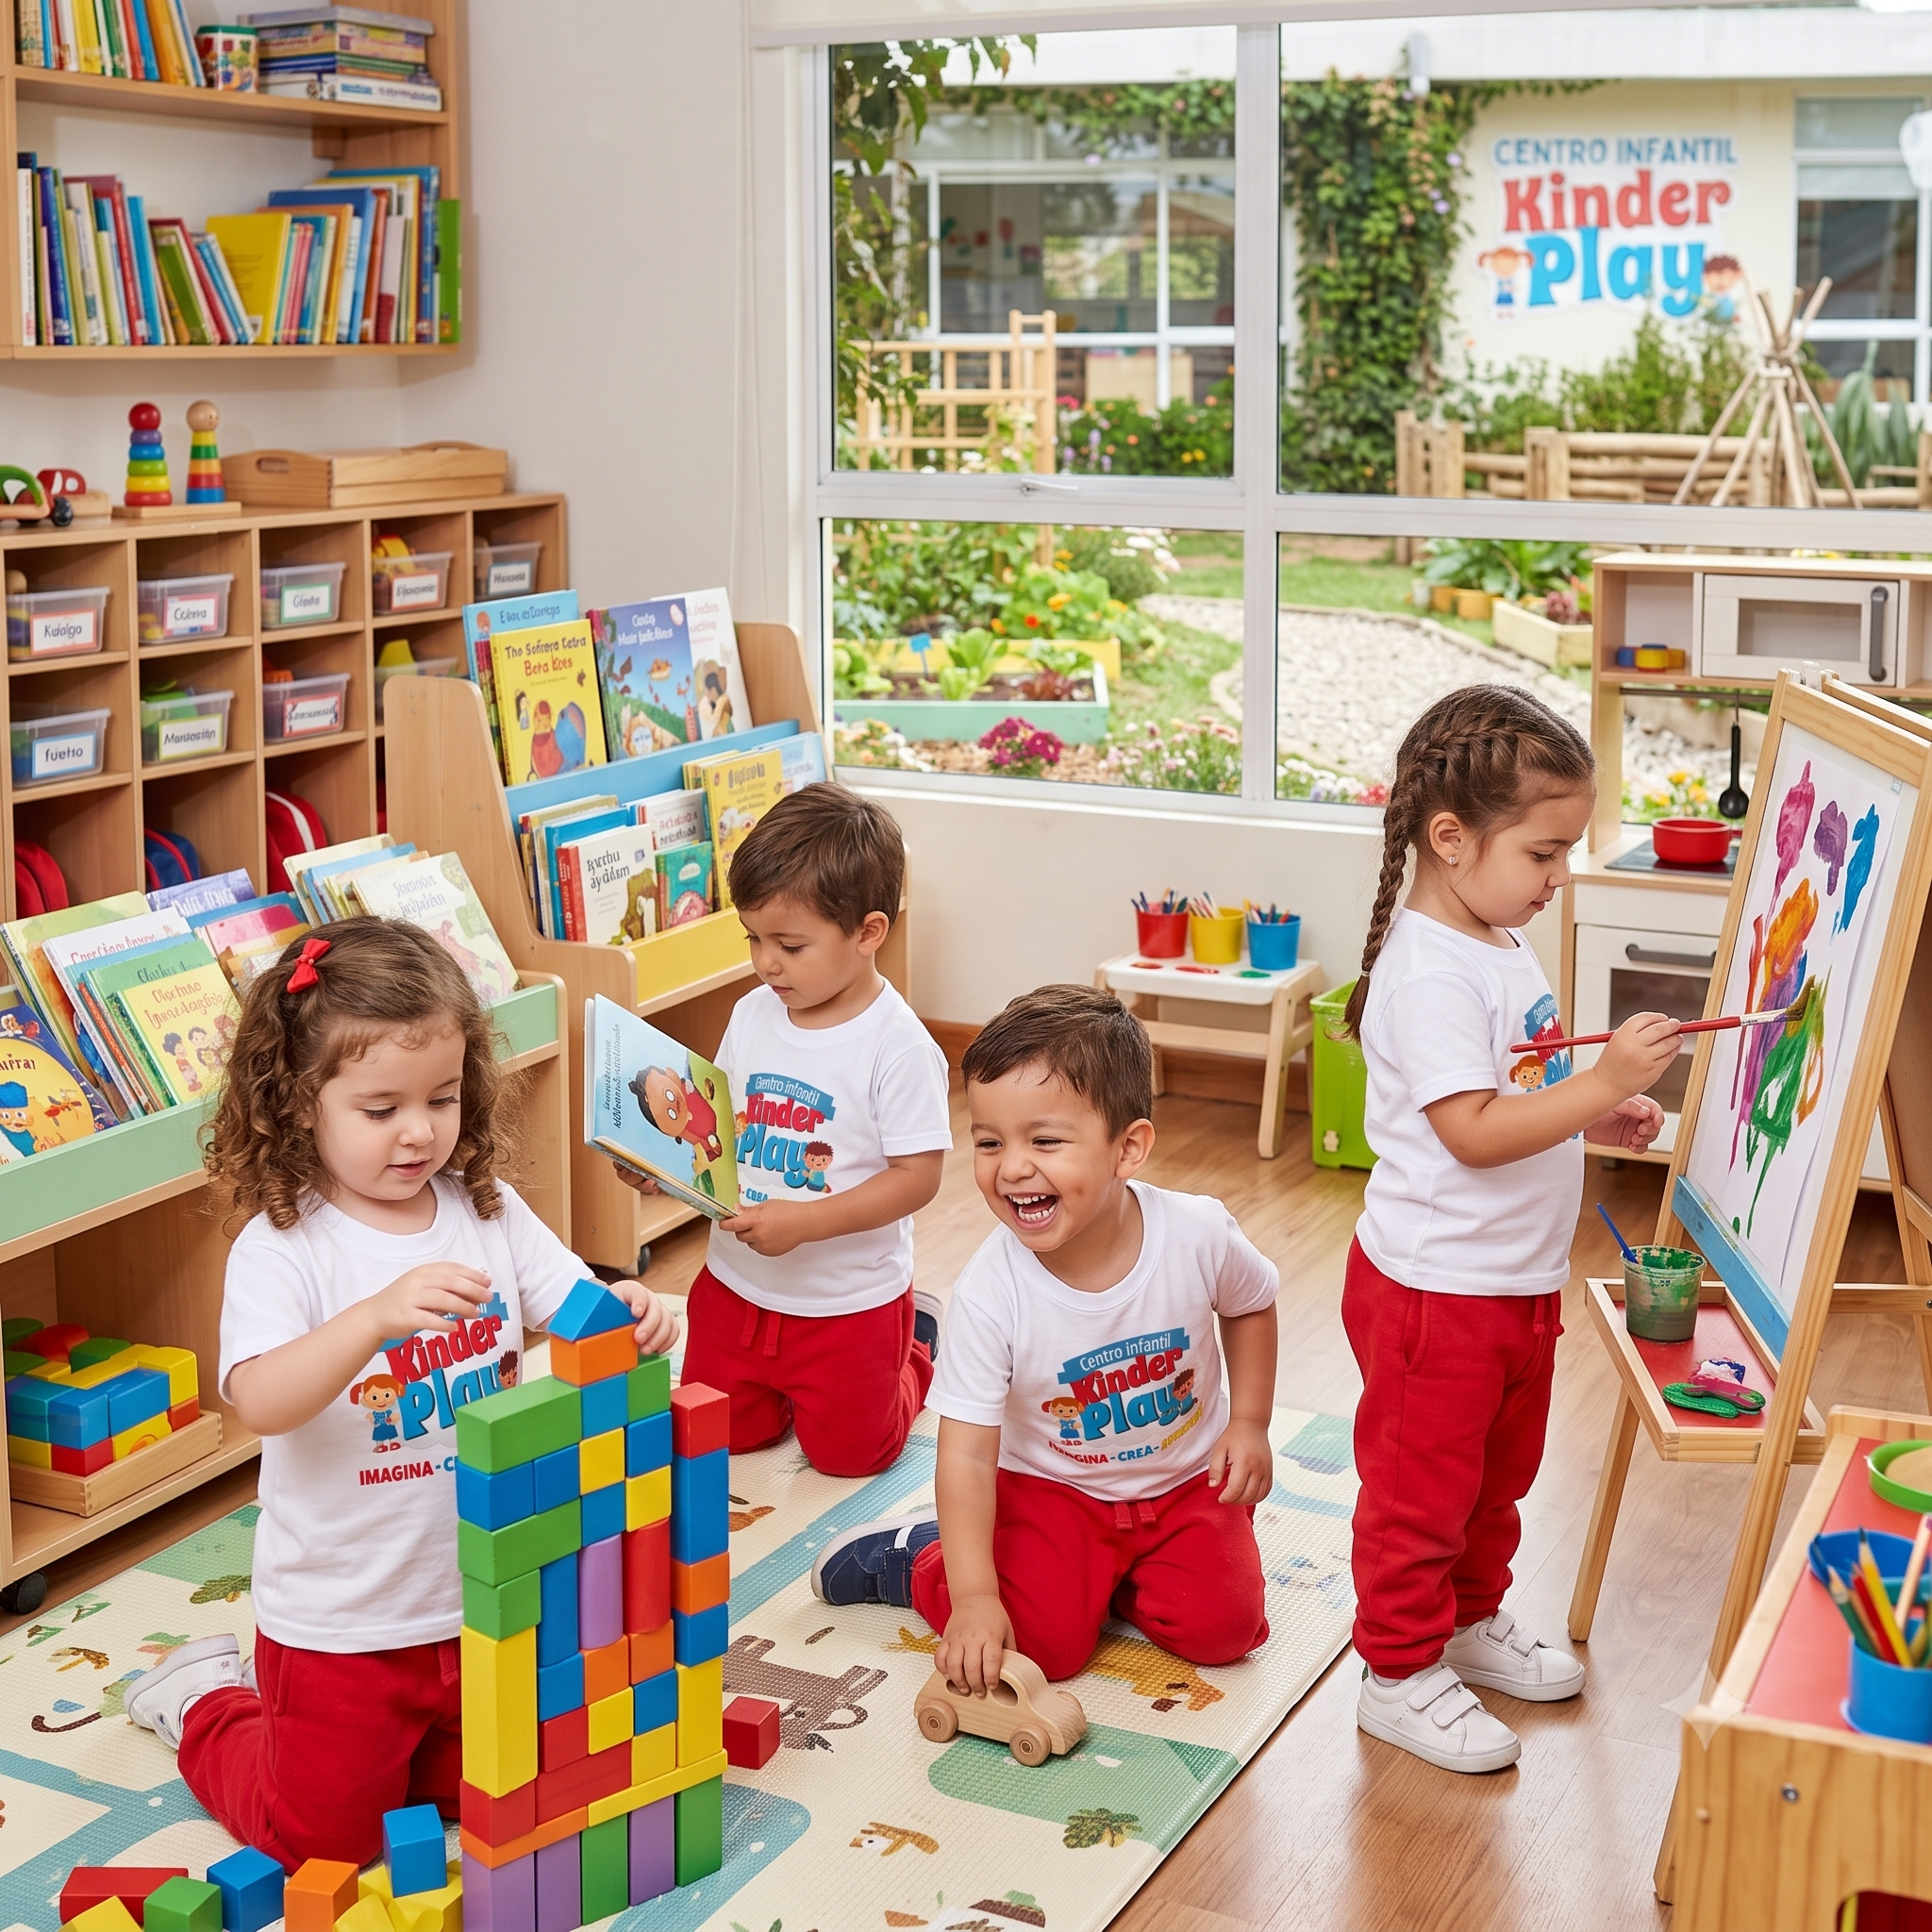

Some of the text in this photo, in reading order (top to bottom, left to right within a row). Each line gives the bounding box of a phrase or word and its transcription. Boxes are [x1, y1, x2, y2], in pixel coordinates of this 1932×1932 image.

[1493, 137, 1738, 166] CENTRO INFANTIL
[1502, 168, 1731, 233] Kinder
[1524, 226, 1706, 317] Play
[745, 1092, 825, 1133] Kinder
[737, 1124, 809, 1189] Play
[385, 1314, 502, 1386] Kinder
[1069, 1347, 1183, 1407] Kinder
[1079, 1332, 1171, 1372] Centro infantil
[1078, 1382, 1193, 1441] Play
[358, 1460, 434, 1486] IMAGINA
[1117, 1444, 1154, 1462] CREA
